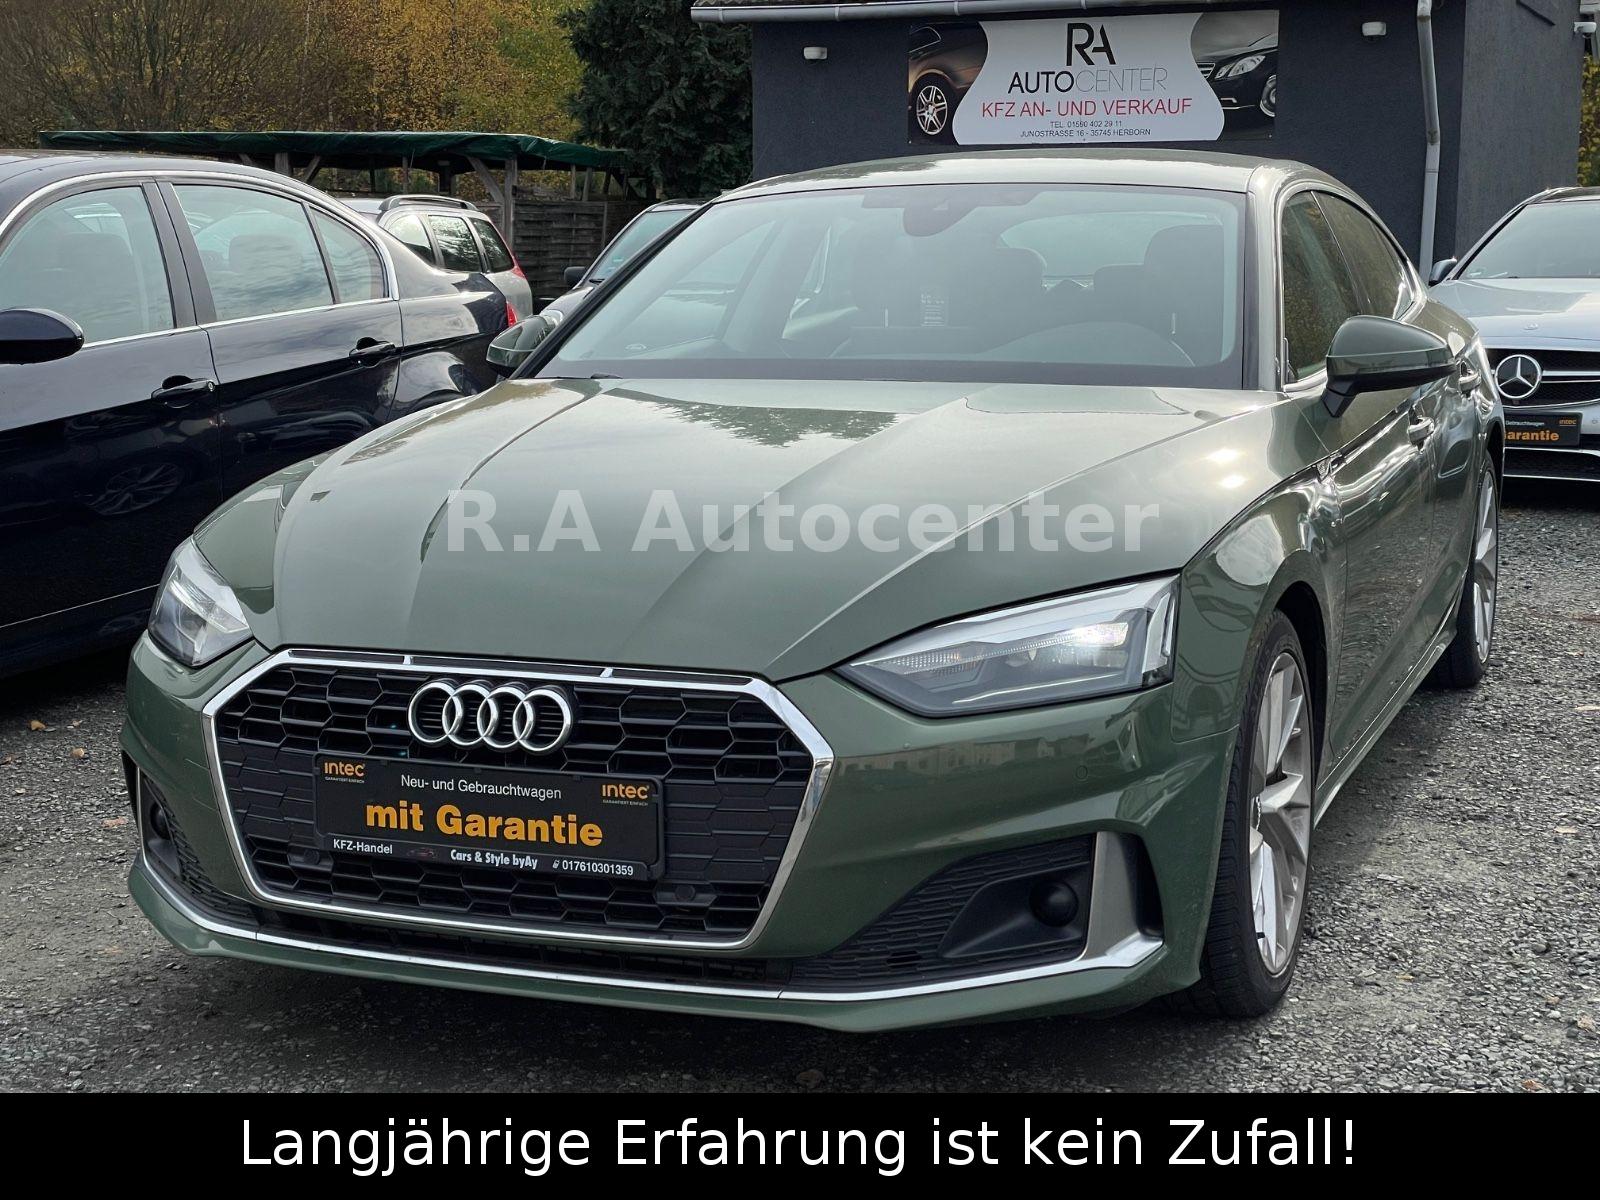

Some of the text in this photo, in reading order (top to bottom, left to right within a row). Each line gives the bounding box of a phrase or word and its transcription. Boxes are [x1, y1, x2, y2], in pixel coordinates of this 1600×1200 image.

[1066, 22, 1116, 66] RA
[1008, 67, 1168, 94] AUTOCENTER
[982, 98, 1192, 118] KFZ AN- UND VERKAUF
[1113, 128, 1151, 136] HERBORN
[324, 762, 364, 776] intec
[401, 774, 561, 801] Neu- und Gebrauchtwagen
[602, 784, 648, 799] intec
[367, 800, 603, 846] mit Garantie
[333, 839, 393, 854] KFZ-Handel
[451, 849, 538, 869] Cars & Style byAy
[562, 859, 634, 875] 017610301359
